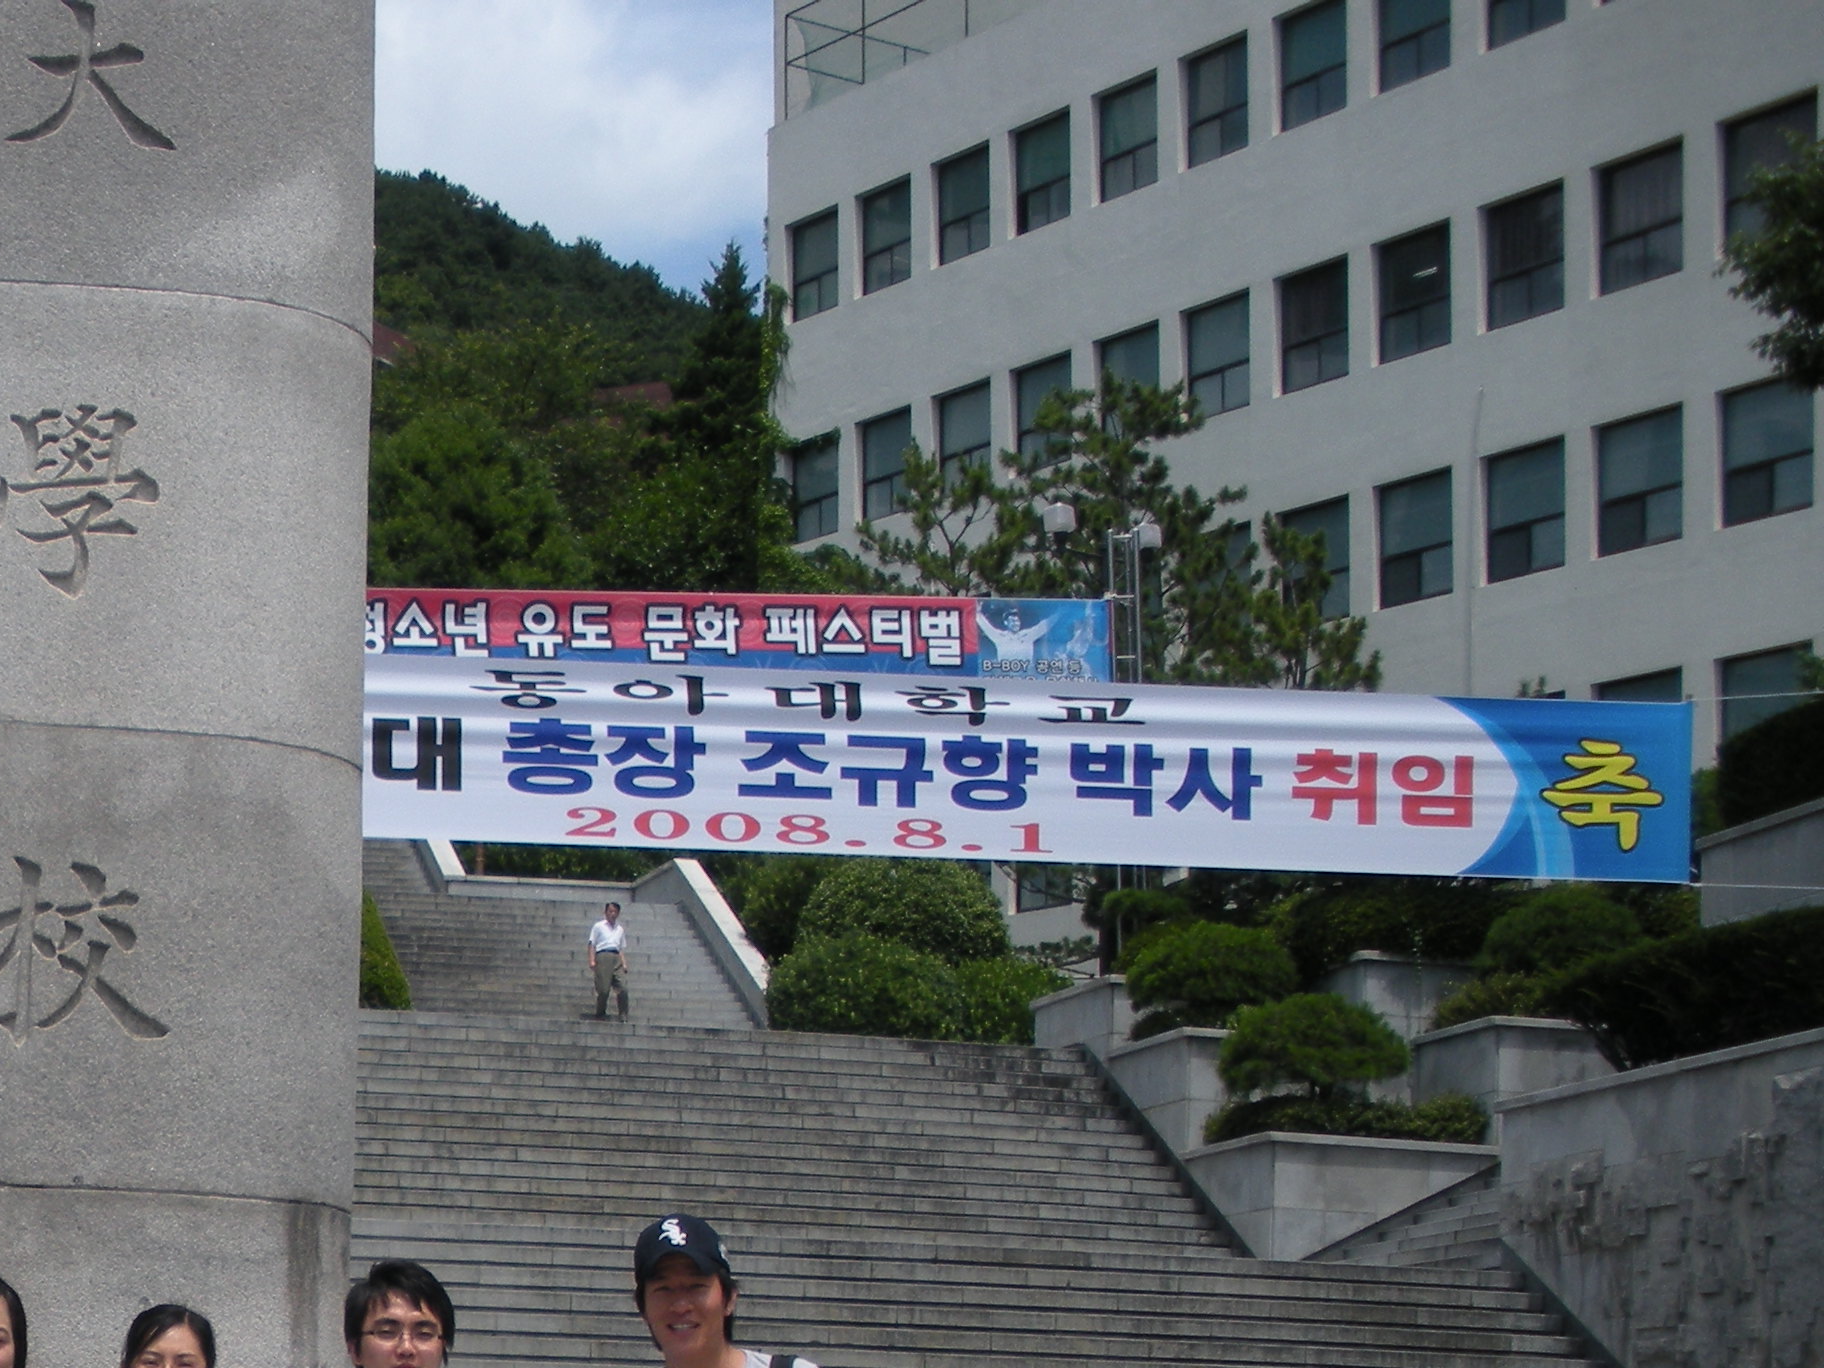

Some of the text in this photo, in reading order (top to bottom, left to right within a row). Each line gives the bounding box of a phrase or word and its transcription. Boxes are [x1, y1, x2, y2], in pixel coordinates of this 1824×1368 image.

[516, 604, 613, 652] 유도
[644, 603, 740, 661] 문화
[766, 607, 961, 667] 페스티벌
[983, 659, 1029, 671] B-BOY
[1036, 659, 1063, 673] 공연
[372, 717, 1476, 828] 대 총장 조규향 박사 취임
[1539, 737, 1664, 852] 축
[565, 806, 1054, 854] 2008.8.1
